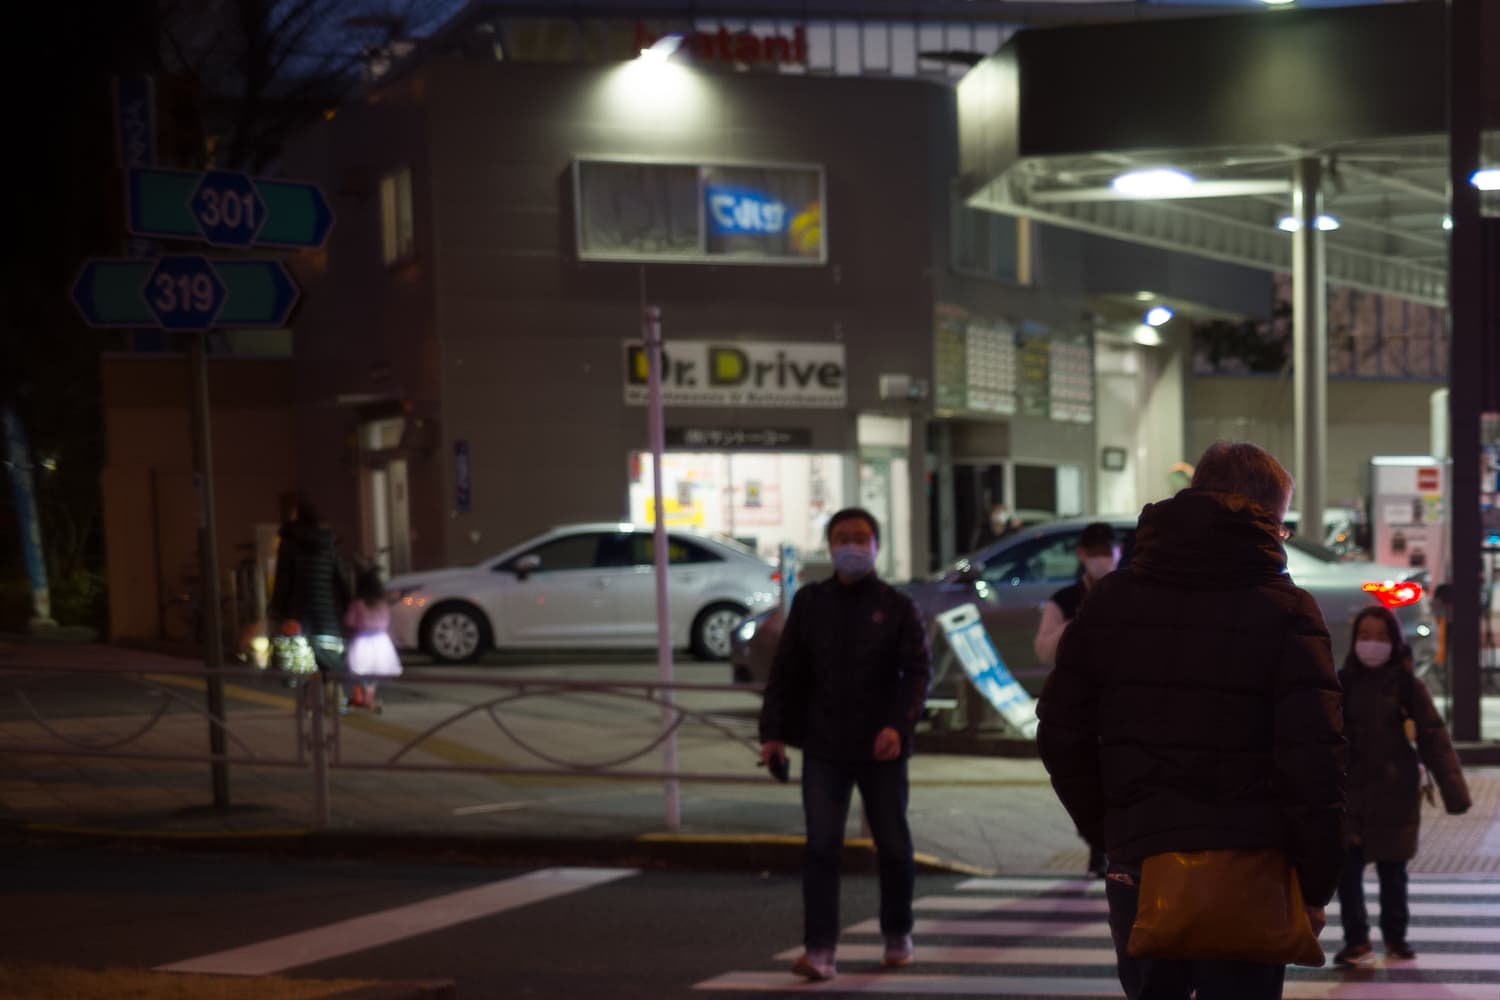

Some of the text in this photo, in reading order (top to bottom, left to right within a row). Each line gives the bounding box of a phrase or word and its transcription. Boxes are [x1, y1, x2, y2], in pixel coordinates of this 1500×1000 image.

[635, 22, 806, 62] Iatani
[199, 187, 255, 230] 301
[155, 272, 214, 314] 319
[708, 347, 843, 389] Drive
